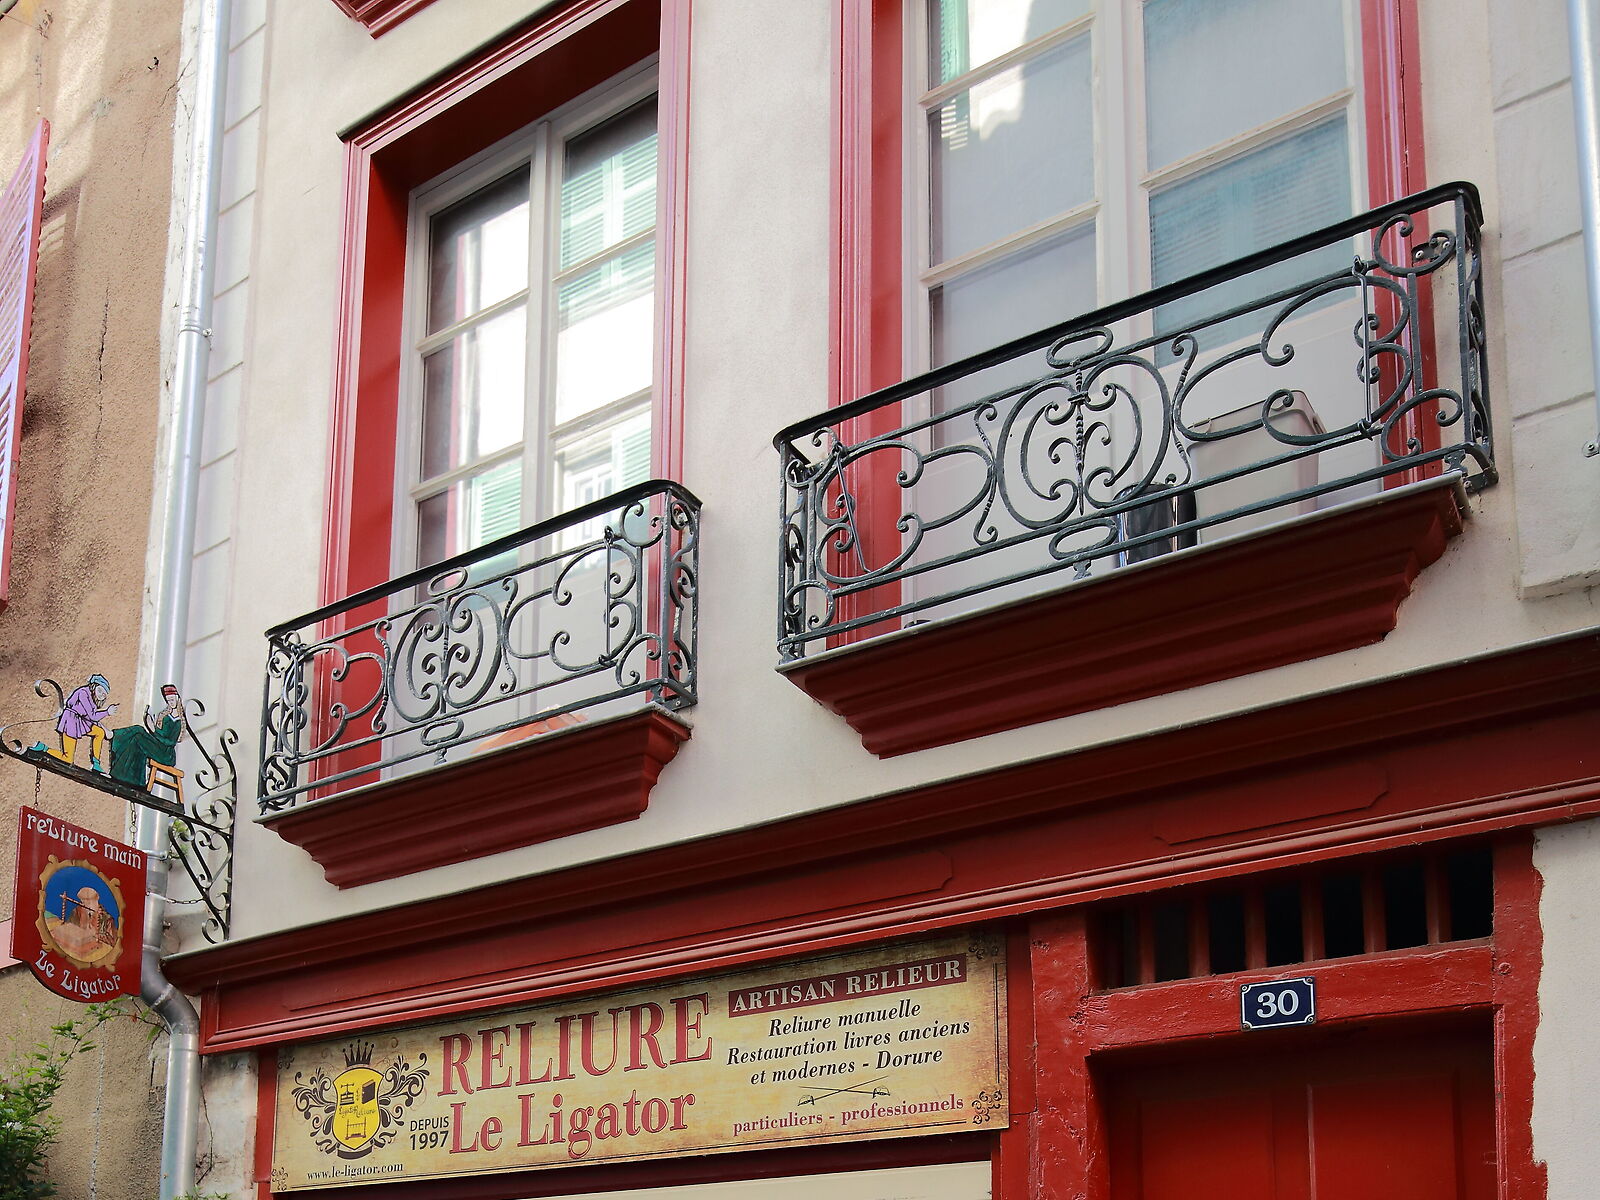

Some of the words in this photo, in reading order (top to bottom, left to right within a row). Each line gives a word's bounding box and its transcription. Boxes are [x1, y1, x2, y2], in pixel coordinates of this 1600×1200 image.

[103, 843, 142, 870] main
[35, 950, 56, 978] Le
[60, 969, 121, 999] Ligator
[732, 979, 837, 1013] ARTISAN
[846, 959, 962, 995] RELIEUR
[768, 1015, 832, 1038] Reliure
[837, 998, 922, 1028] manuelle
[1256, 989, 1299, 1019] 30
[437, 992, 713, 1097] RELIURE
[726, 1036, 838, 1066] Restauration
[844, 1031, 892, 1051] livres
[897, 1018, 971, 1043] anciens
[750, 1070, 767, 1085] et
[771, 1056, 856, 1084] modernes
[875, 1047, 943, 1070] Dorure
[409, 1115, 450, 1132] DEPUIS
[449, 1101, 503, 1154] Le
[517, 1089, 696, 1159] Ligator
[732, 1110, 824, 1137] particuliers
[840, 1093, 965, 1126] professionnels
[409, 1130, 450, 1151] 1997
[306, 1162, 404, 1181] www.le-ligator.com
